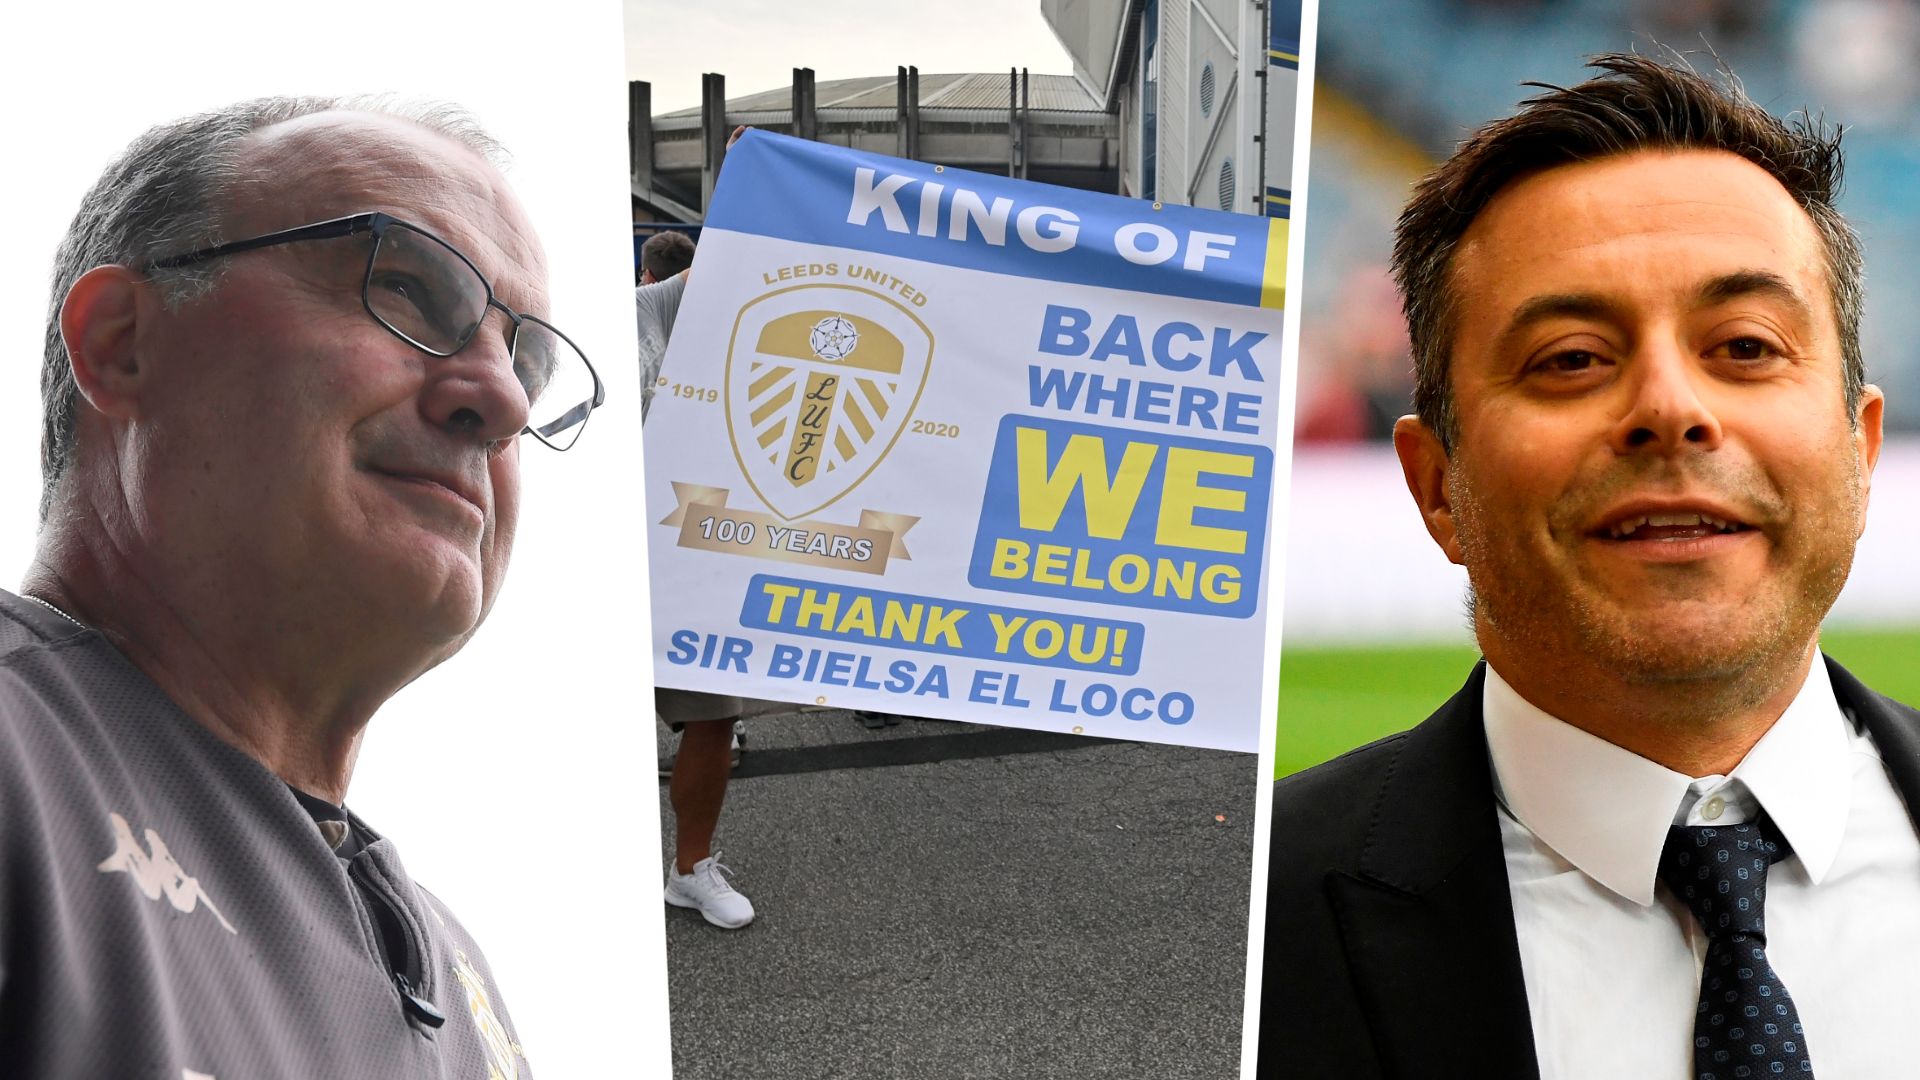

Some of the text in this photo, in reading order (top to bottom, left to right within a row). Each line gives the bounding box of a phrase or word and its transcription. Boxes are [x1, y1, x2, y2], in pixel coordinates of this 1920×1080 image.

[846, 167, 1237, 272] KING OF
[763, 264, 928, 307] LEEDS UNITED
[1038, 304, 1269, 383] BACK
[671, 382, 719, 404] 1919
[1028, 366, 1263, 435] WHERE
[912, 419, 960, 438] 2020
[1015, 427, 1255, 554] WE
[699, 516, 874, 563] 100 YEARS
[989, 538, 1242, 604] BELONG
[762, 583, 1129, 667] THANK YOU!
[666, 629, 1196, 725] SIR BIELSA EL LOCO
